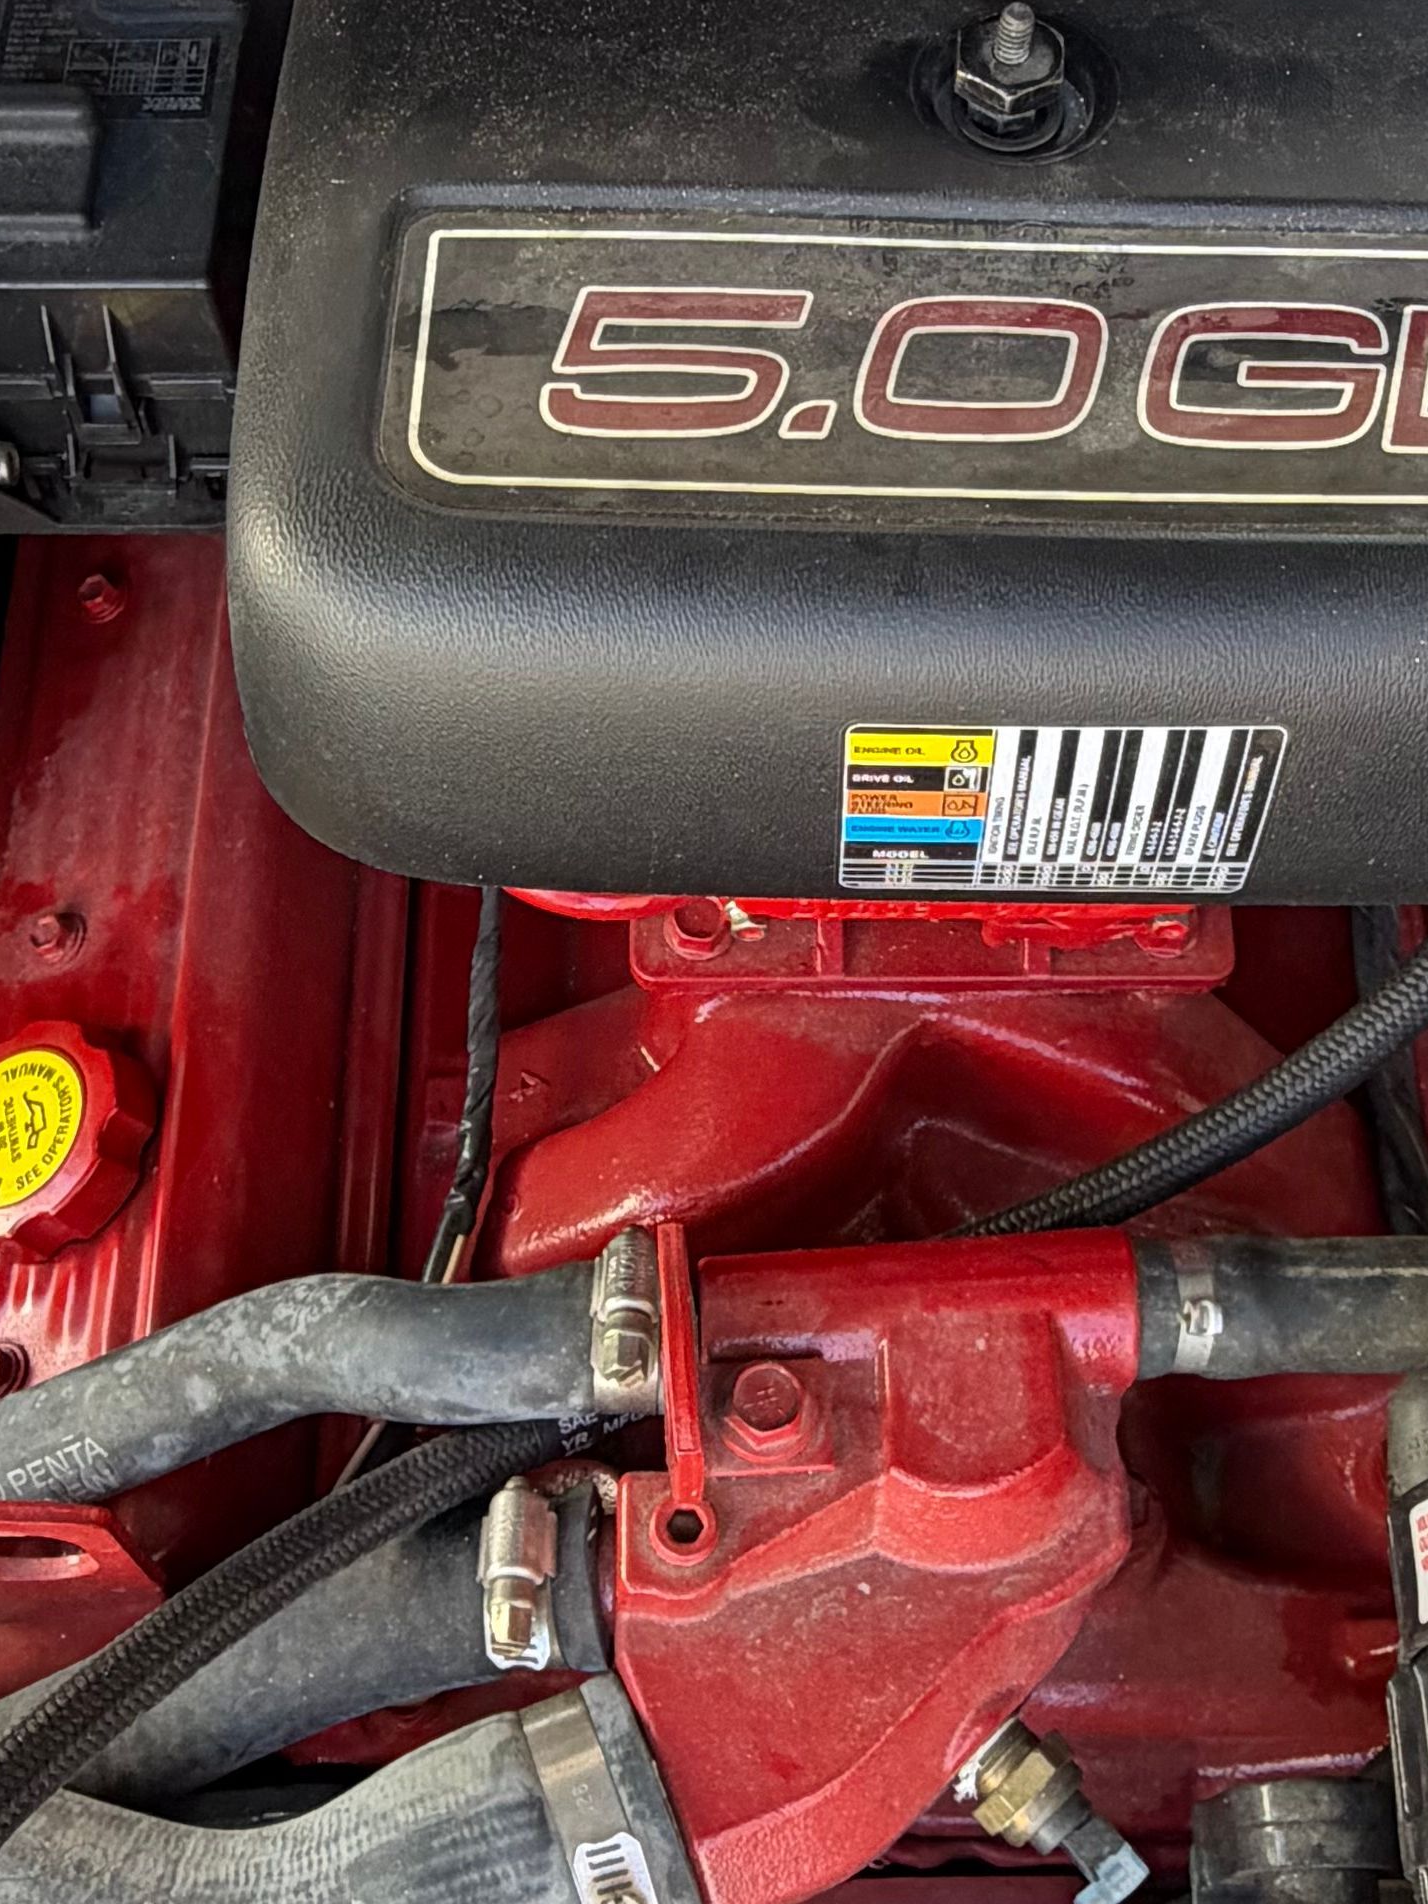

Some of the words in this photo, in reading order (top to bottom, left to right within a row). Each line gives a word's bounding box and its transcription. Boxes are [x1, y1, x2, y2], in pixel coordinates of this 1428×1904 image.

[851, 774, 890, 783] DRIVE
[892, 774, 914, 783] OIL
[872, 849, 929, 859] MODEL
[1, 1062, 58, 1084] MANUAL
[3, 1096, 22, 1164] SYNTHETIC
[16, 1164, 42, 1191] SEE
[558, 1412, 599, 1434] SAE
[6, 1433, 110, 1500] PENTA
